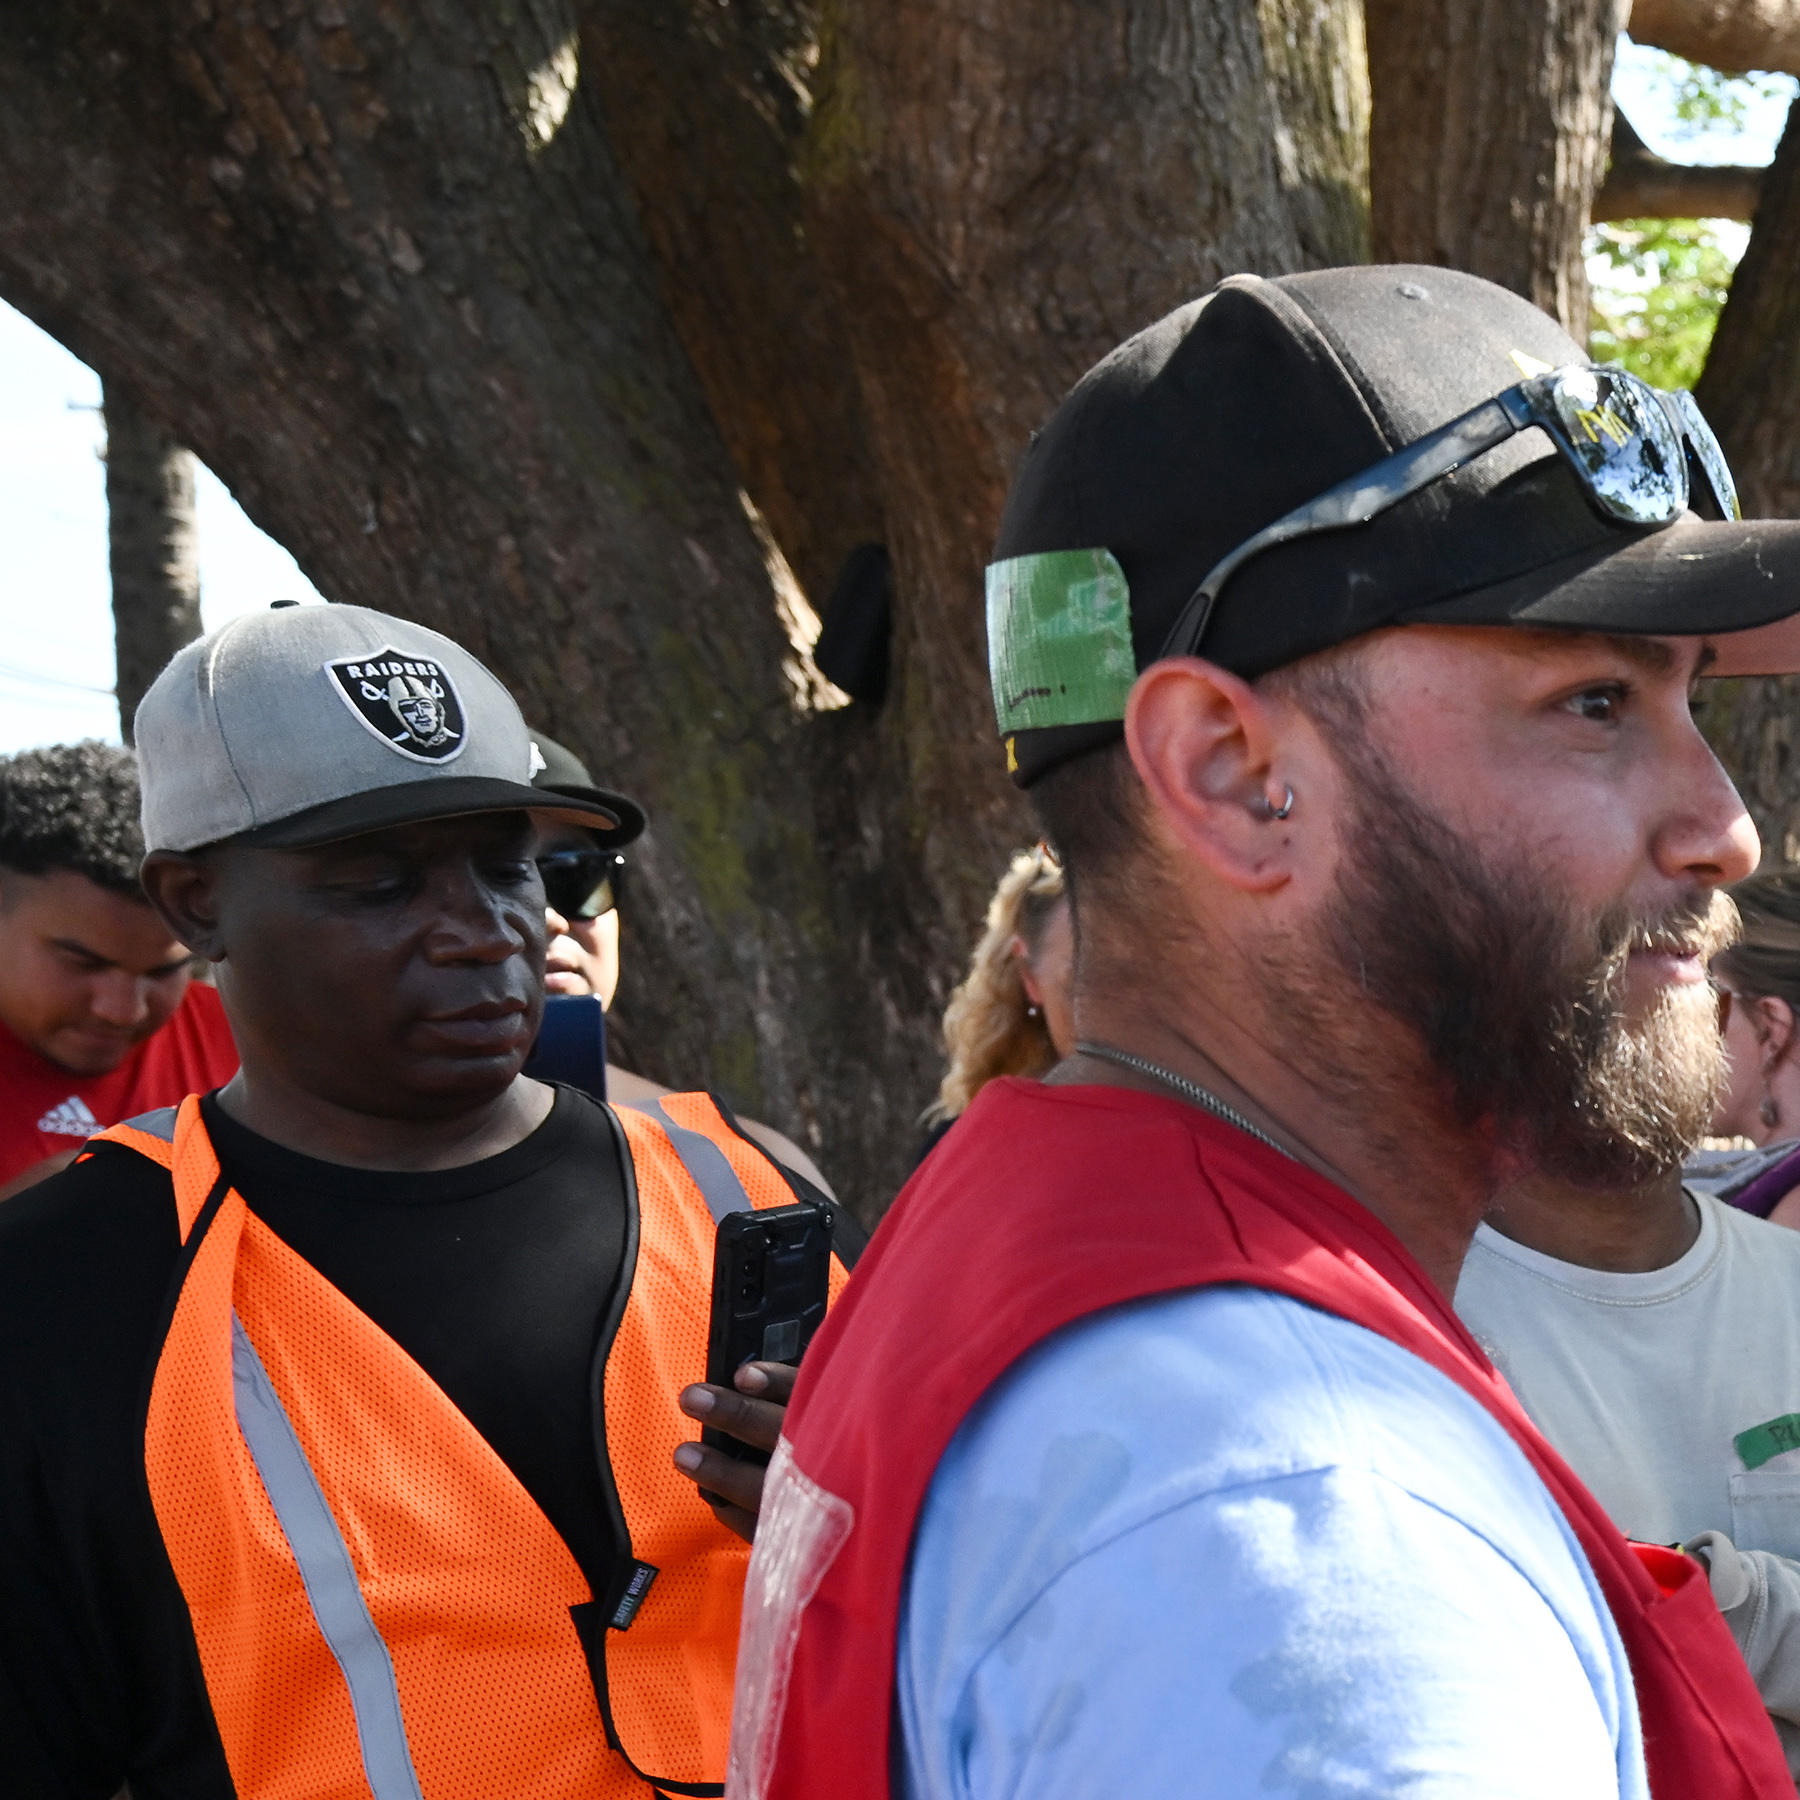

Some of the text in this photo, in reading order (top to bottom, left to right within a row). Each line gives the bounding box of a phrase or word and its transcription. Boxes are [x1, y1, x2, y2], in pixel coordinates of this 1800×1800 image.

[346, 661, 439, 680] RAIDERS
[612, 1567, 649, 1624] SAFETY WORKS
